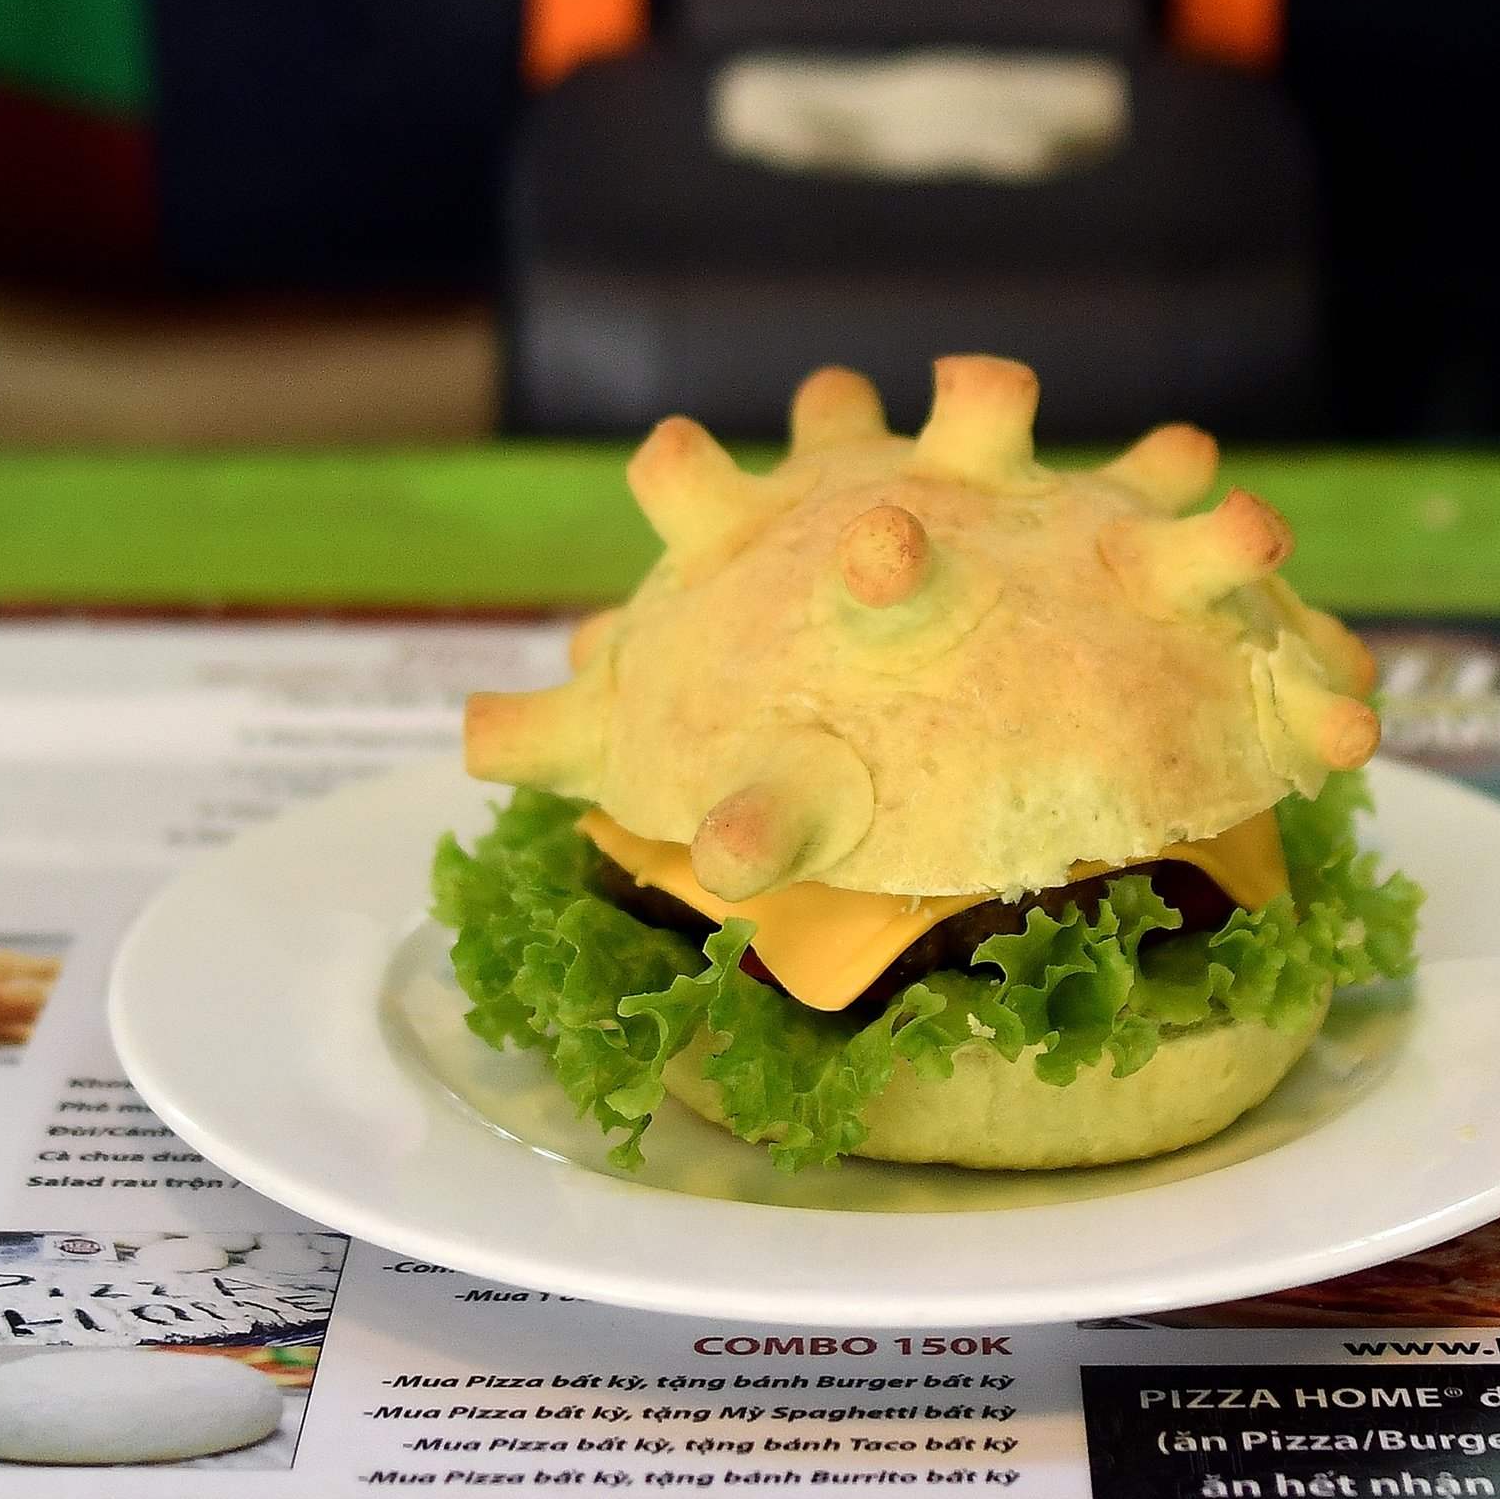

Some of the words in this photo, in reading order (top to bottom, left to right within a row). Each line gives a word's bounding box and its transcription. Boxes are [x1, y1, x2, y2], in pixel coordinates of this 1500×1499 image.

[26, 1176, 106, 1188] Salad
[111, 1177, 159, 1189] rau
[165, 1177, 224, 1192] trộn
[693, 1336, 879, 1357] COMBO
[893, 1336, 1014, 1357] 150K
[381, 1374, 460, 1389] -Mua
[464, 1375, 545, 1389] Pizza
[550, 1373, 604, 1389] bất
[656, 1375, 726, 1392] tặng
[733, 1374, 809, 1389] bánh
[815, 1375, 919, 1391] Burger
[923, 1373, 975, 1389] bất
[1139, 1388, 1282, 1409] PIZZA
[363, 1405, 442, 1420] -Mua
[447, 1405, 528, 1420] Pizza
[534, 1404, 588, 1420] bất
[641, 1406, 713, 1422] tặng
[770, 1405, 919, 1423] Spaghetti
[923, 1404, 976, 1420] bất
[402, 1437, 483, 1452] -Mua
[487, 1437, 569, 1452] Pizza
[575, 1435, 628, 1451] bất
[685, 1437, 756, 1454] tặng
[763, 1437, 842, 1452] bánh
[850, 1437, 918, 1451] Taco
[924, 1435, 976, 1451] bất
[1156, 1429, 1229, 1456] (ăn
[443, 1470, 527, 1485] Pizza
[532, 1469, 587, 1485] bất
[644, 1470, 715, 1487] tặng
[723, 1469, 802, 1484] bánh
[810, 1469, 919, 1485] Burrito
[925, 1468, 978, 1484] bất
[1201, 1472, 1262, 1498] ăn
[1274, 1469, 1359, 1498] hết
[1370, 1471, 1496, 1499] nhận
